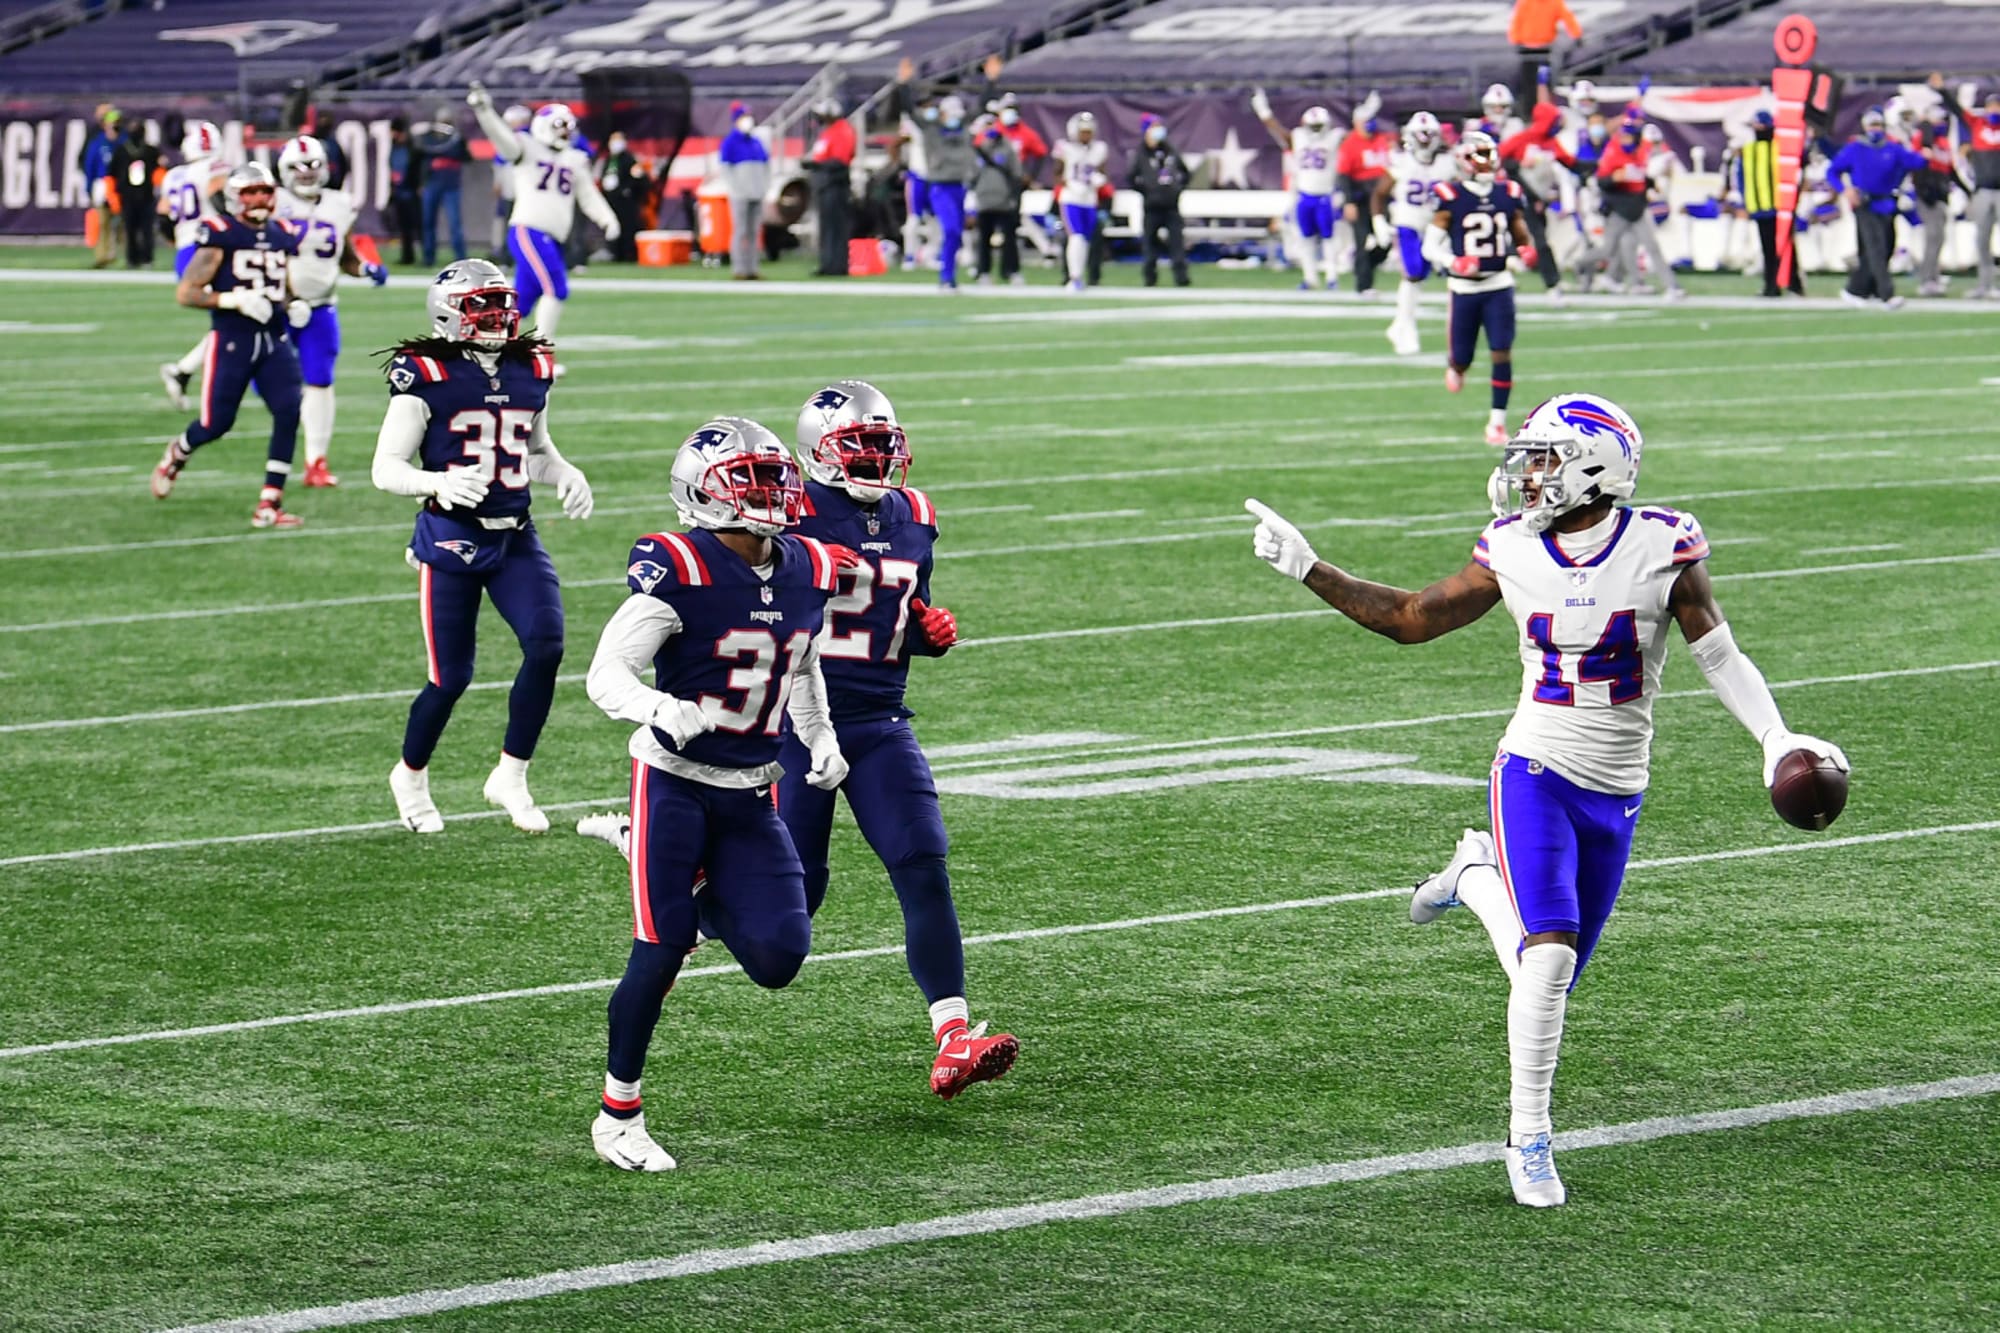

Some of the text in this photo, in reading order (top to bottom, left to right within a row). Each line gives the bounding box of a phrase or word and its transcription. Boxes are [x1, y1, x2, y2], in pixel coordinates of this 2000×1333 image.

[536, 162, 574, 195] 76
[286, 218, 338, 258] 73
[1462, 212, 1507, 258] 21
[232, 250, 287, 302] 55
[446, 408, 536, 490] 35
[750, 611, 783, 625] PATRIOTS
[819, 556, 920, 663] 27
[1565, 598, 1596, 607] BILLS
[1527, 609, 1643, 706] 14
[697, 628, 812, 737] 31
